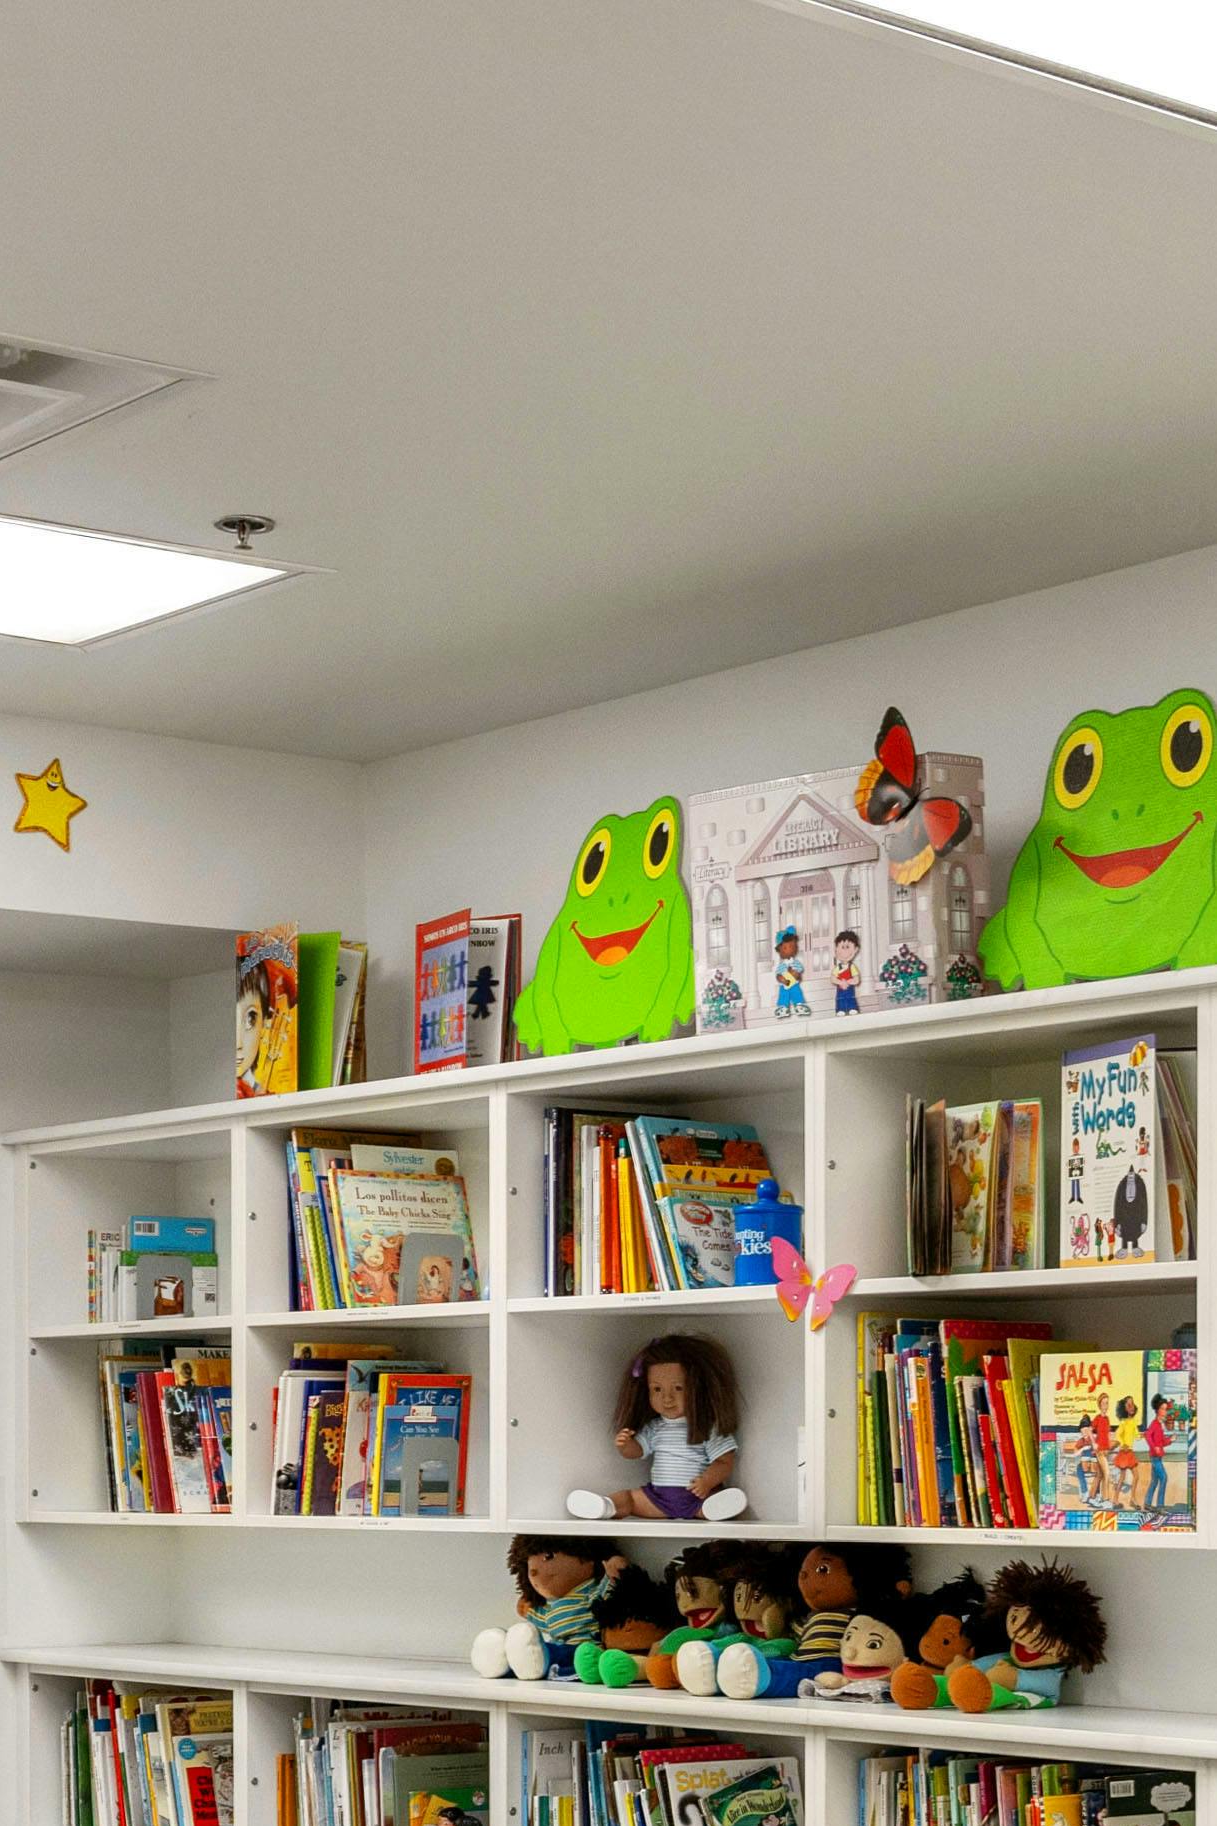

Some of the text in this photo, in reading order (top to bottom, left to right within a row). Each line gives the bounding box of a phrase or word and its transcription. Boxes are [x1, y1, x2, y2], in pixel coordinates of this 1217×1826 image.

[785, 817, 824, 835] LITERACY
[773, 828, 841, 856] LIBRARY
[697, 867, 726, 881] Literacy
[1080, 1061, 1137, 1105] My Fun
[1081, 1097, 1136, 1136] Words
[382, 1150, 425, 1167] Sylvester
[355, 1187, 448, 1205] Los pollitos dicen
[357, 1205, 375, 1216] The
[378, 1206, 399, 1219] Baby
[401, 1207, 431, 1218] Chicks
[692, 1226, 711, 1238] The
[1055, 1360, 1113, 1393] SALSA
[400, 1425, 414, 1434] Can
[416, 1424, 428, 1434] You
[539, 1742, 564, 1756] Inch
[675, 1767, 729, 1792] Splat
